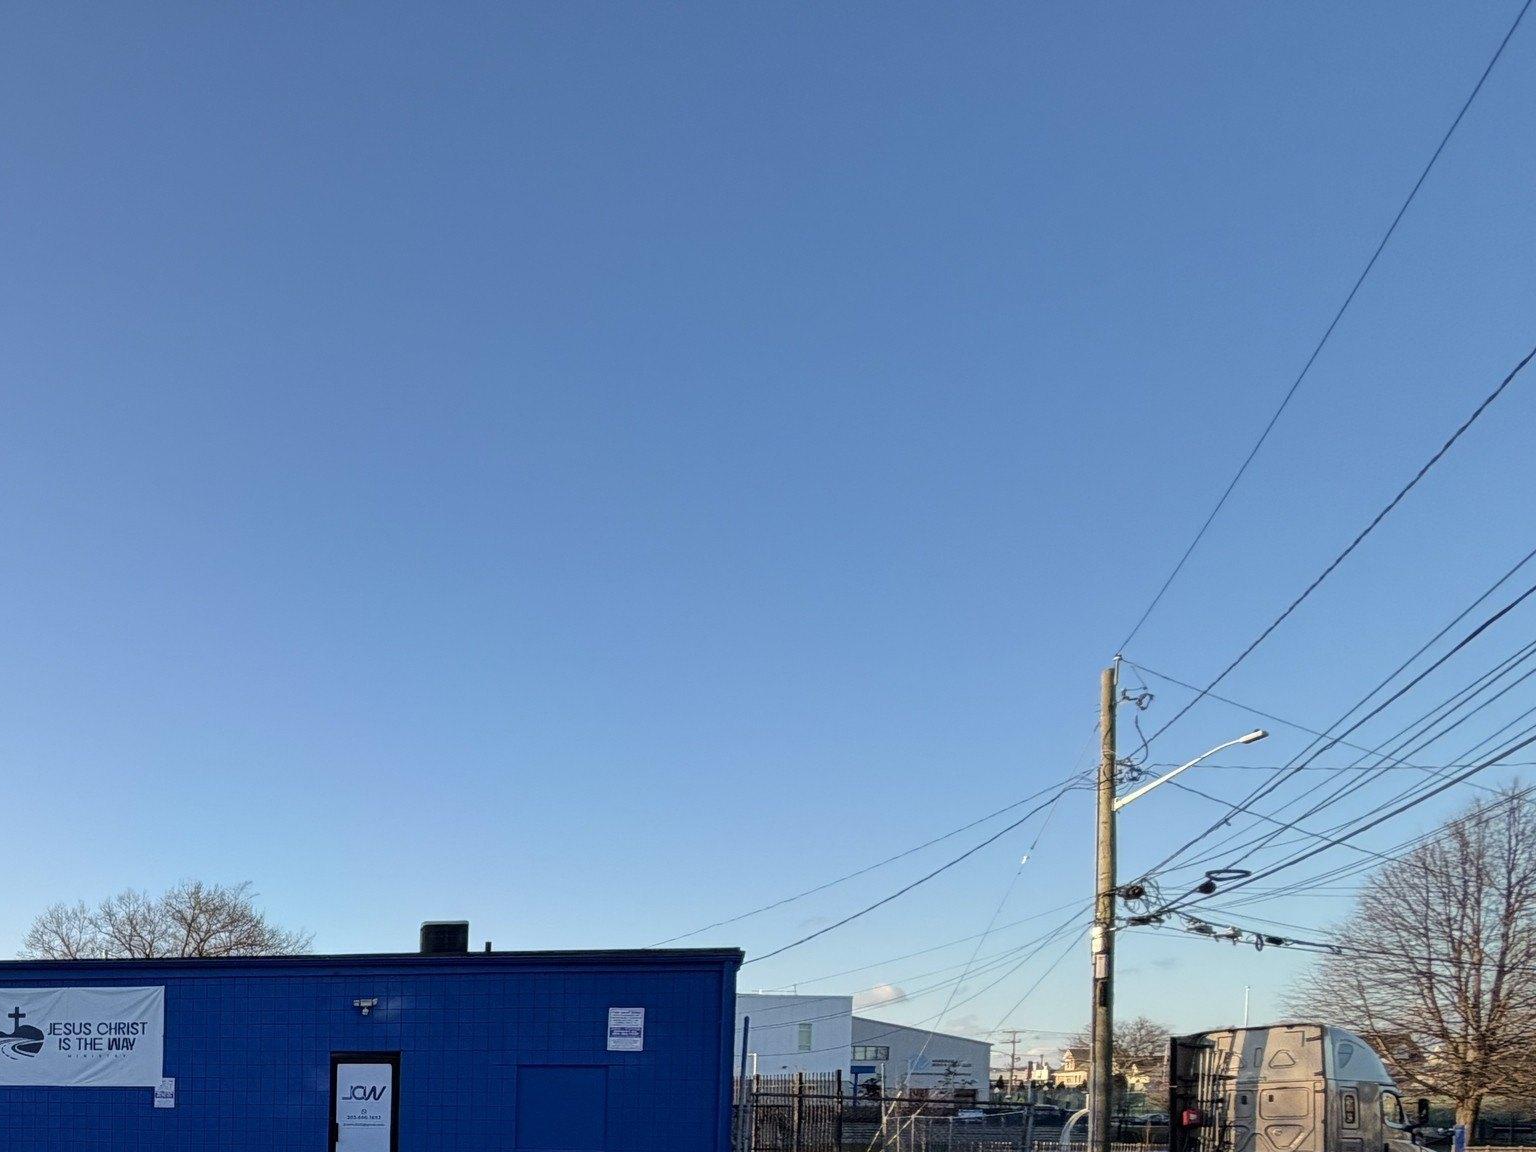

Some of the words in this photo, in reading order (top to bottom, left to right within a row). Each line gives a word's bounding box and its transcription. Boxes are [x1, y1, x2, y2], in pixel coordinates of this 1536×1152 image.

[47, 1022, 92, 1036] JESUS
[96, 1022, 148, 1036] CHRIST
[58, 1037, 71, 1051] IS
[76, 1037, 103, 1051] THE
[107, 1037, 136, 1051] WAY
